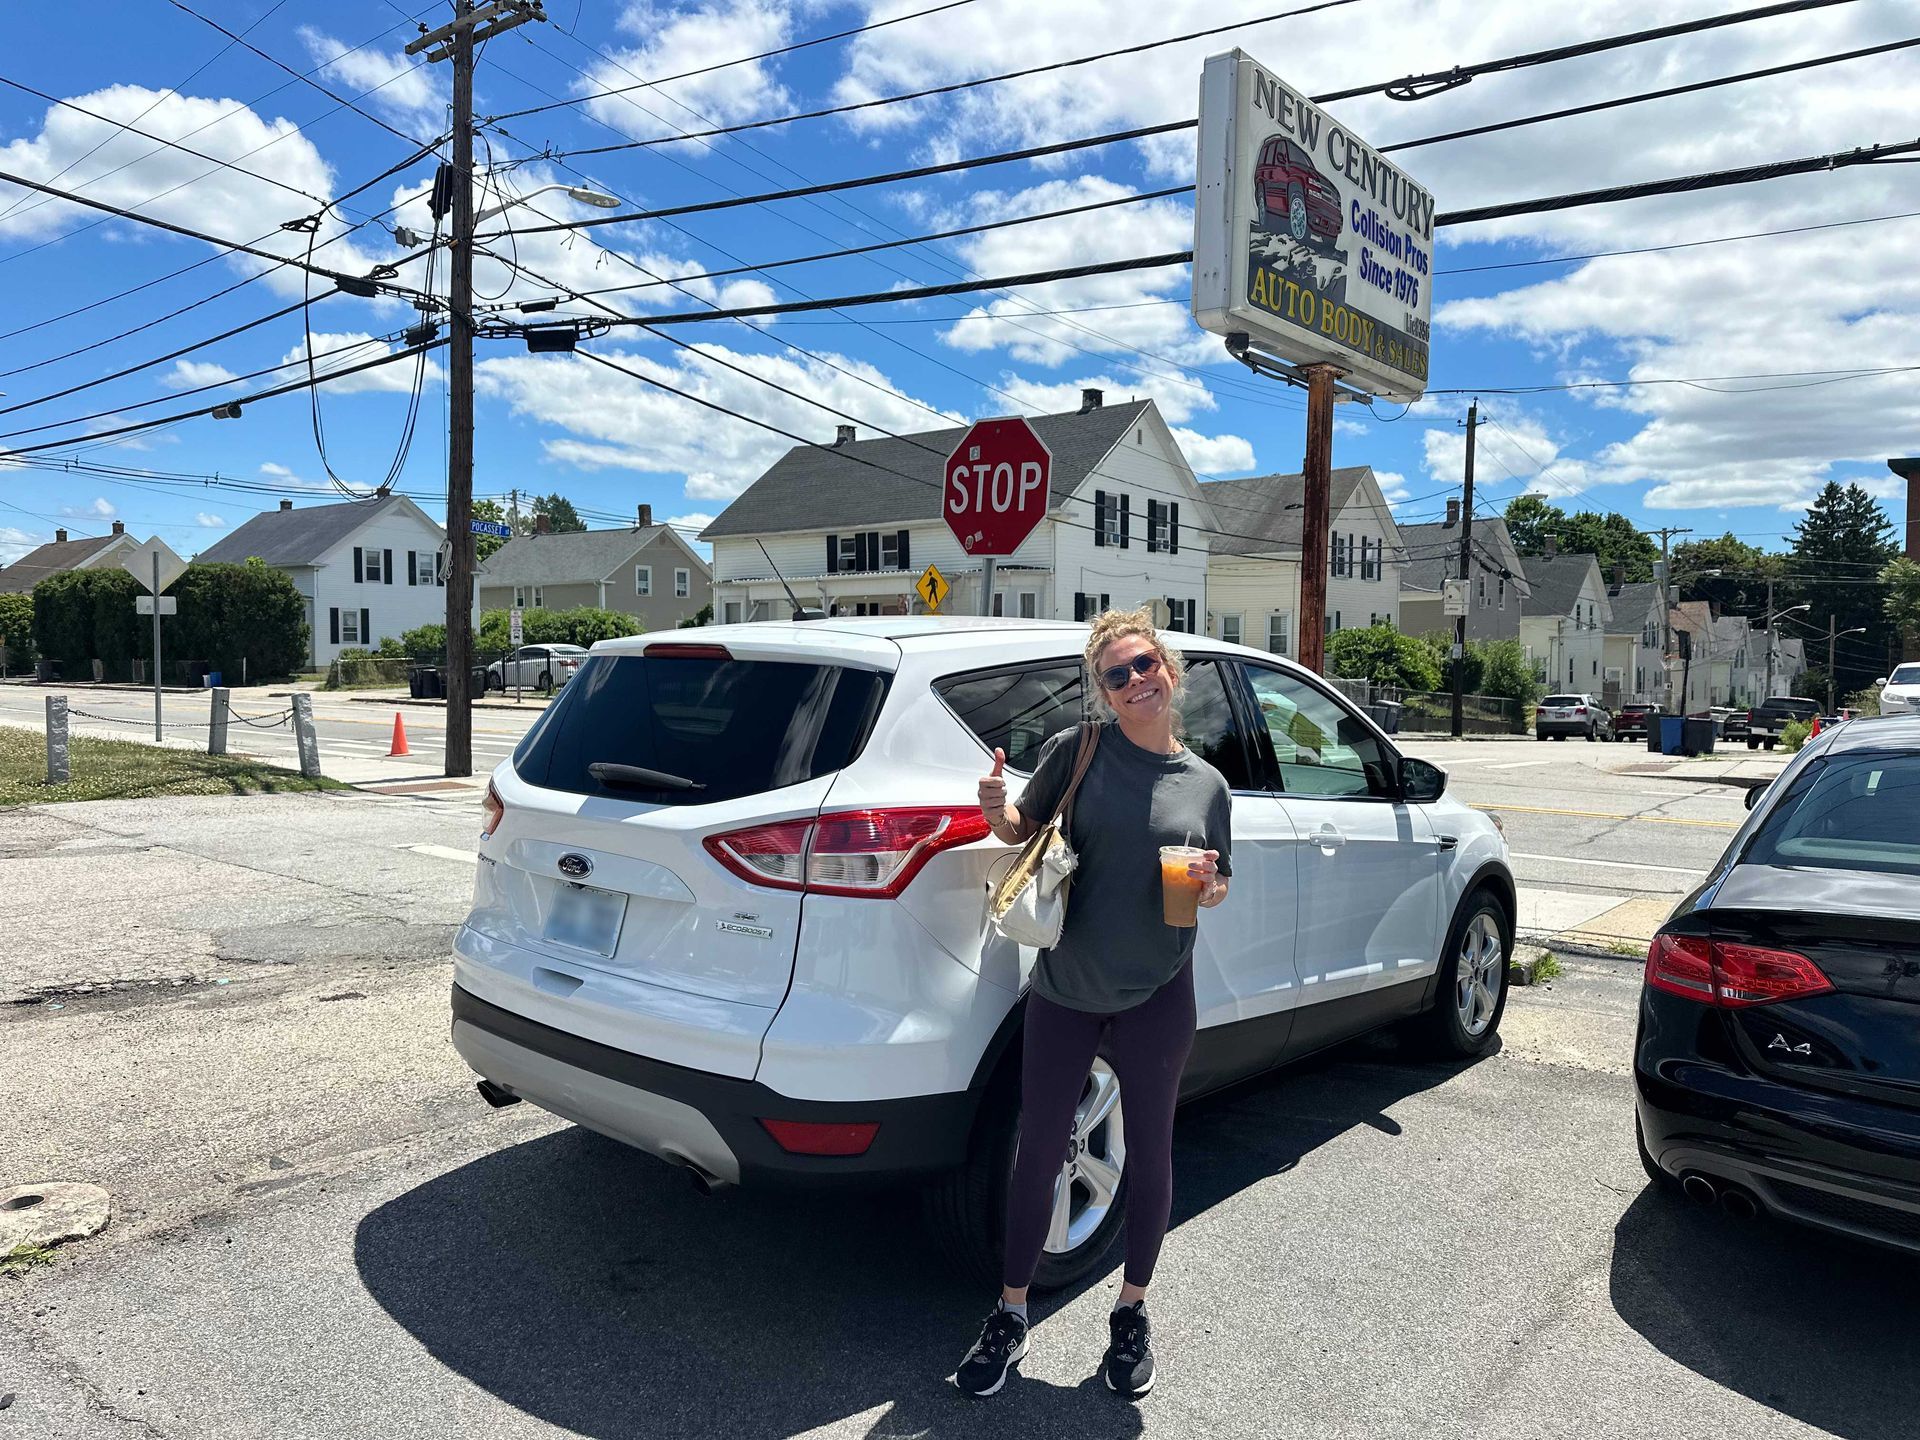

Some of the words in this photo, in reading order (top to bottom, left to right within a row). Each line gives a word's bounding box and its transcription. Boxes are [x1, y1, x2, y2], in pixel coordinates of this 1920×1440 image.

[1254, 68, 1321, 151] NEW
[1327, 126, 1434, 241] CENTURY
[1351, 199, 1402, 260] Collision
[1405, 233, 1428, 276] Pros
[1360, 246, 1392, 294] Since
[1395, 267, 1419, 308] 1976
[1251, 267, 1315, 326] AUTO
[1321, 298, 1375, 352] BODY
[1375, 334, 1385, 359] &
[1388, 340, 1428, 378] SALES
[950, 461, 1042, 514] STOP
[471, 521, 502, 535] POCASSET
[1768, 1033, 1811, 1055] A4
